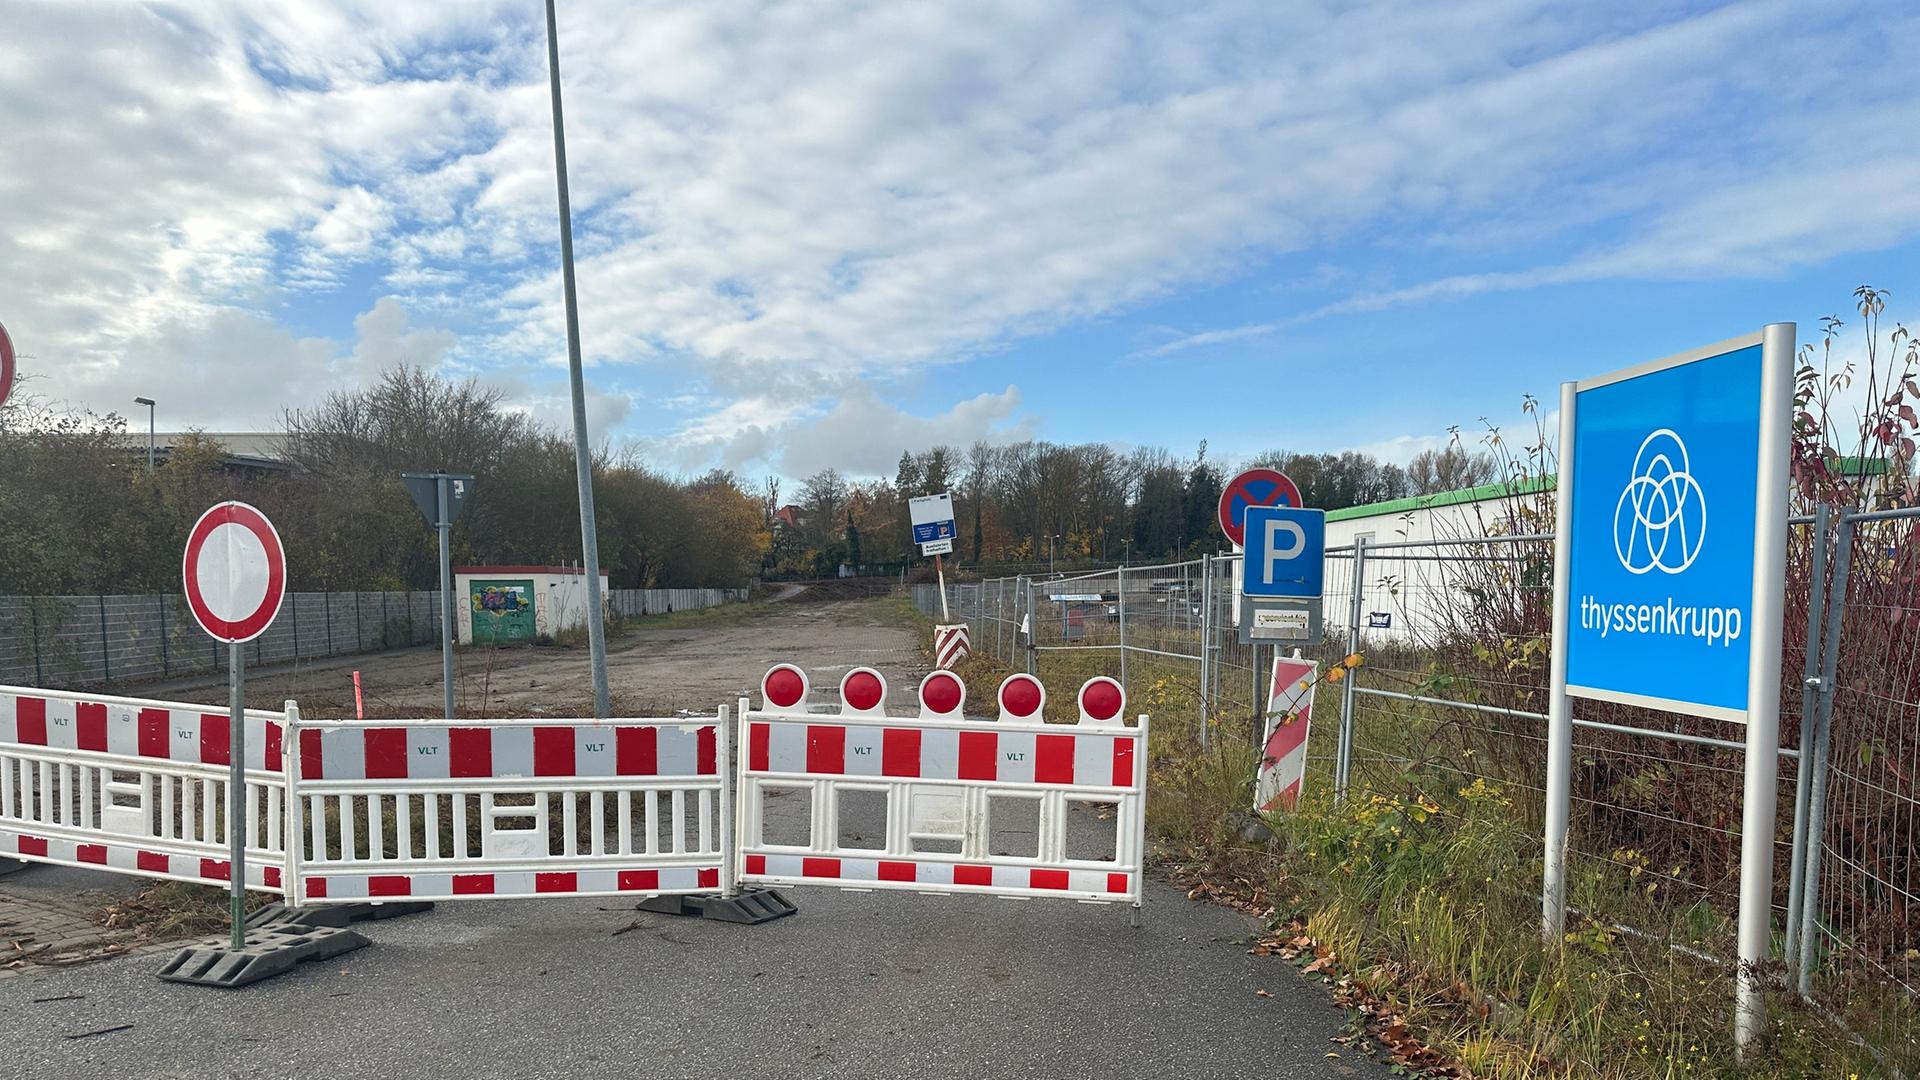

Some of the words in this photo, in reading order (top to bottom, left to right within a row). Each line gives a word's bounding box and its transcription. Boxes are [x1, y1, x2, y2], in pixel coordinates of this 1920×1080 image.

[1263, 519, 1305, 584] P
[1581, 595, 1742, 647] thyssenkrupp
[54, 718, 69, 726] VLT
[178, 730, 193, 739] VLT
[418, 746, 438, 755] VLT
[586, 743, 605, 752] VLT
[854, 746, 872, 755] VLT
[1006, 752, 1025, 761] VLT
